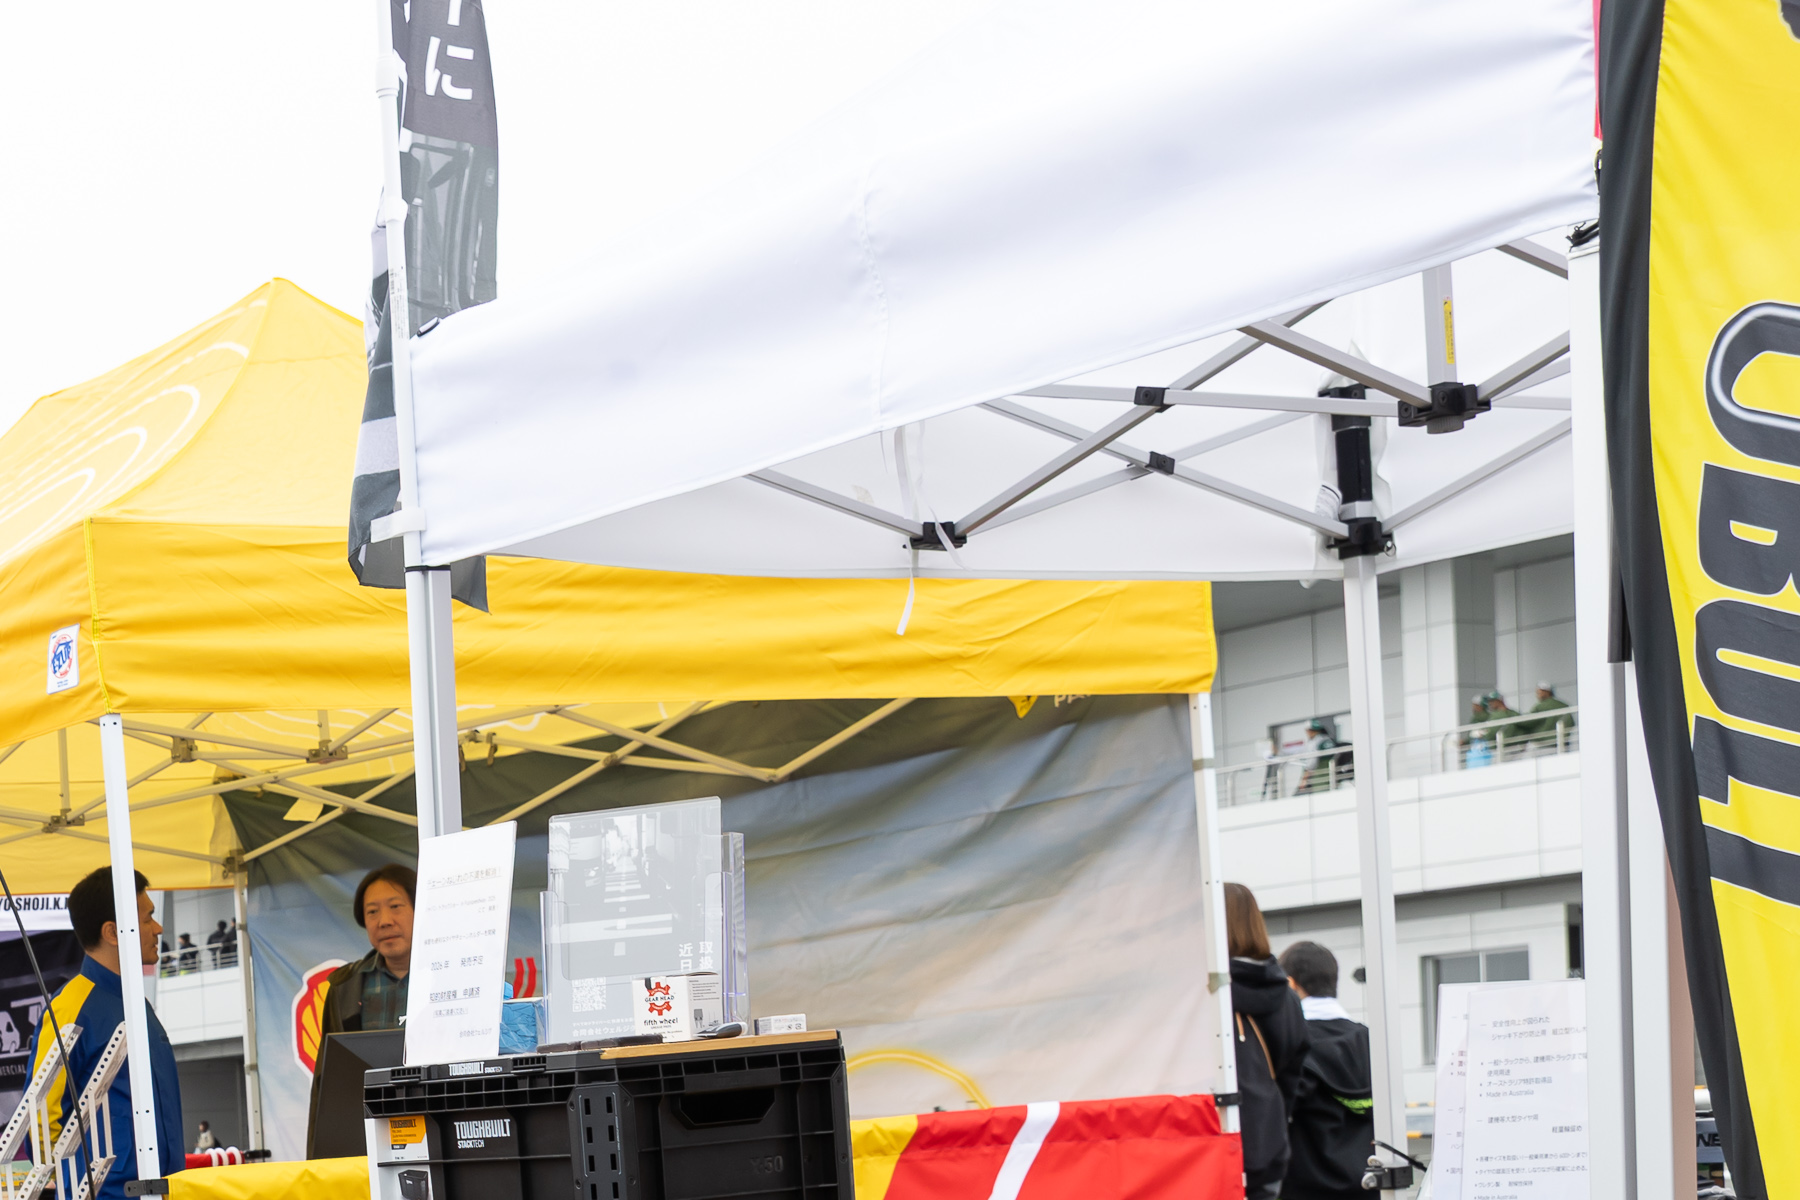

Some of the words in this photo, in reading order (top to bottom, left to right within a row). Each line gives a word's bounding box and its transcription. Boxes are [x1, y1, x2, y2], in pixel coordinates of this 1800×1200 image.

[659, 1017, 678, 1025] wheel
[448, 1061, 485, 1076] TOUGHBUILT
[1509, 1089, 1535, 1097] Australia
[454, 1119, 511, 1139] TOUGHBUILT
[457, 1139, 485, 1149] STACKTECH
